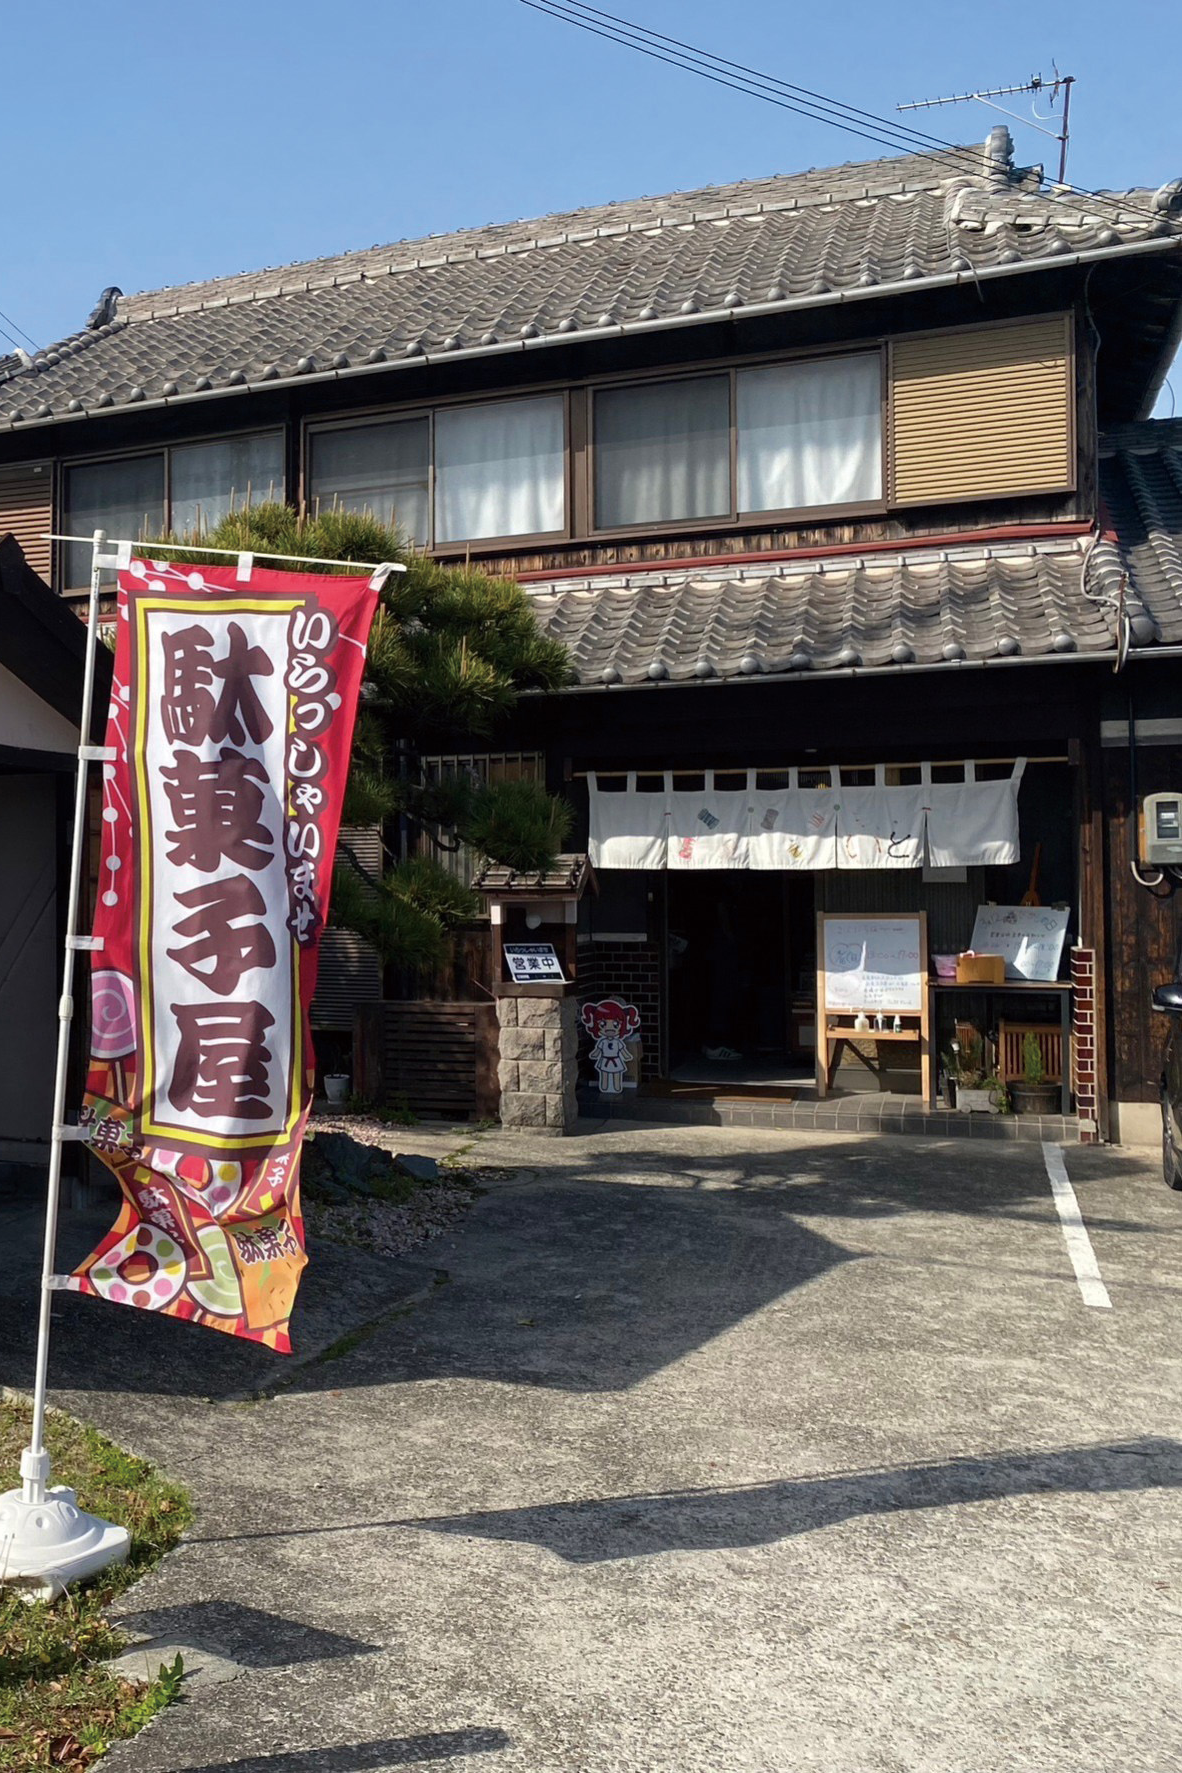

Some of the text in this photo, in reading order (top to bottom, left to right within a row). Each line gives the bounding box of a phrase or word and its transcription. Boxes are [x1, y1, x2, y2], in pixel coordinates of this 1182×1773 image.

[159, 621, 276, 1119] 駄菓子屋
[287, 610, 332, 942] いらっしゃいませ
[512, 956, 555, 971] 営業中
